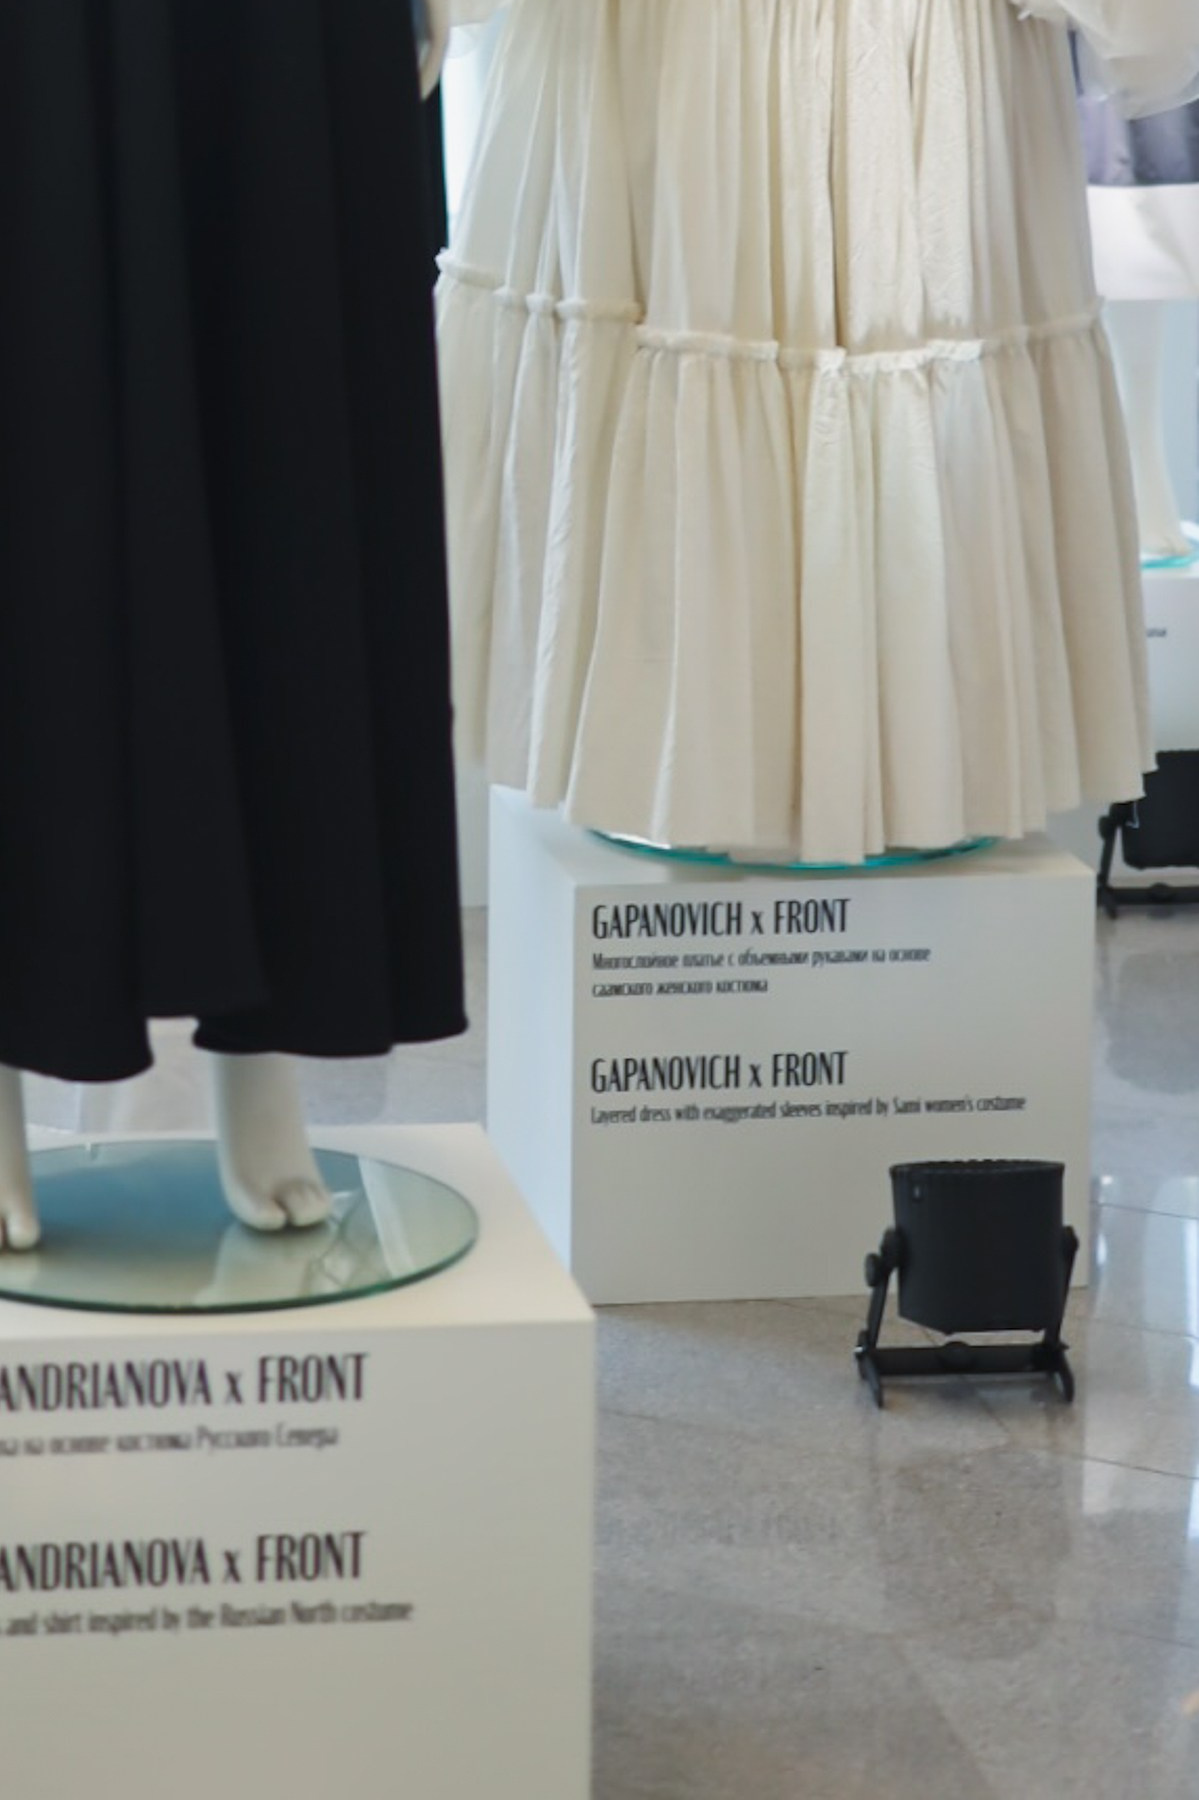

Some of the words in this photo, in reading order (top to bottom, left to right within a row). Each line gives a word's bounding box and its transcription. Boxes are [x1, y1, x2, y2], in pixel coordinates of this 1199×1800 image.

[593, 902, 742, 939] GAPANOVICH
[751, 911, 765, 935] x
[774, 899, 850, 934] FRONT
[593, 953, 679, 970] Многослойное
[682, 954, 724, 967] платье
[656, 981, 713, 995] женского
[716, 980, 768, 993] костюма
[591, 1055, 740, 1093] GAPANOVICH
[749, 1063, 763, 1088] x
[772, 1052, 847, 1087] FRONT
[591, 1106, 636, 1124] Layered
[640, 1105, 671, 1122] dress
[675, 1104, 700, 1121] with
[703, 1102, 776, 1123] exaggerated
[780, 1101, 823, 1118] sleeves
[825, 1099, 872, 1119] inspired
[876, 1099, 889, 1116] by
[893, 1097, 921, 1114] Sami
[924, 1096, 974, 1113] women's
[976, 1096, 1026, 1111] costume
[225, 1371, 244, 1404] x
[259, 1353, 365, 1403] FRONT
[223, 1550, 243, 1583] x
[257, 1532, 363, 1582] FRONT
[4, 1613, 39, 1637] and
[42, 1613, 82, 1635] shirt
[87, 1608, 158, 1636] inspired
[161, 1608, 181, 1630] by
[187, 1607, 216, 1629] the
[219, 1603, 287, 1628] Russian
[290, 1602, 338, 1624] North
[339, 1602, 413, 1623] costume
